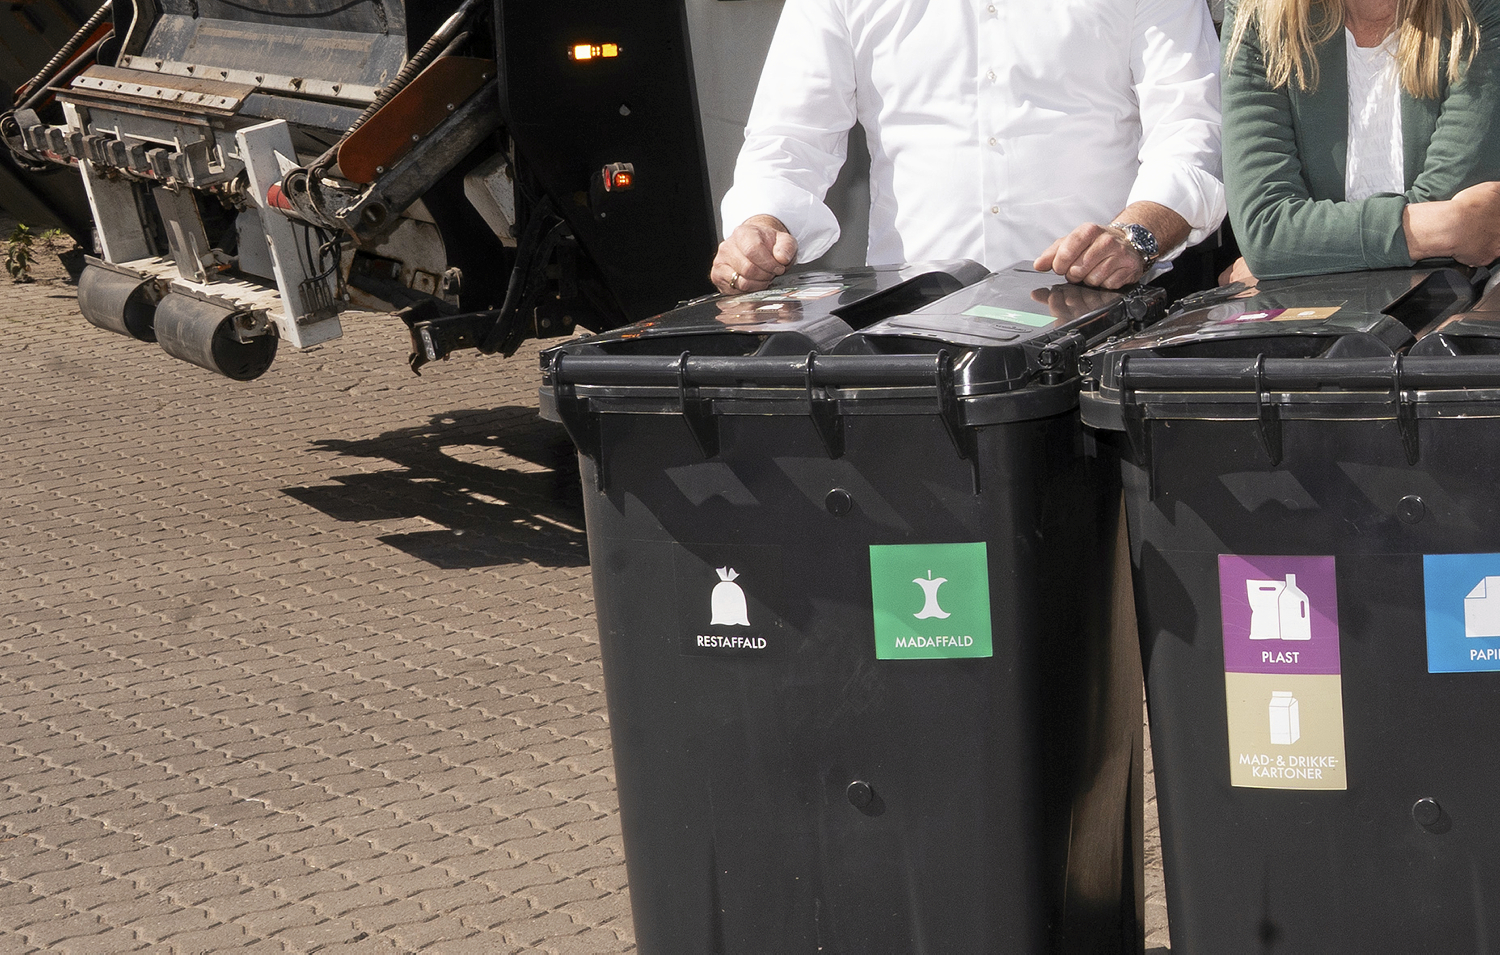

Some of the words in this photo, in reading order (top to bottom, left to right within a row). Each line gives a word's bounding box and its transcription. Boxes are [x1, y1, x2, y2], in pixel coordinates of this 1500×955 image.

[696, 634, 767, 649] RESTAFFALD
[895, 635, 973, 648] MADAFFALD
[1262, 651, 1300, 664] PLAST
[1239, 753, 1274, 766] MAD-
[1276, 755, 1287, 767] &
[1289, 755, 1339, 768] DRIKKE-
[1252, 766, 1323, 780] KARTONER
